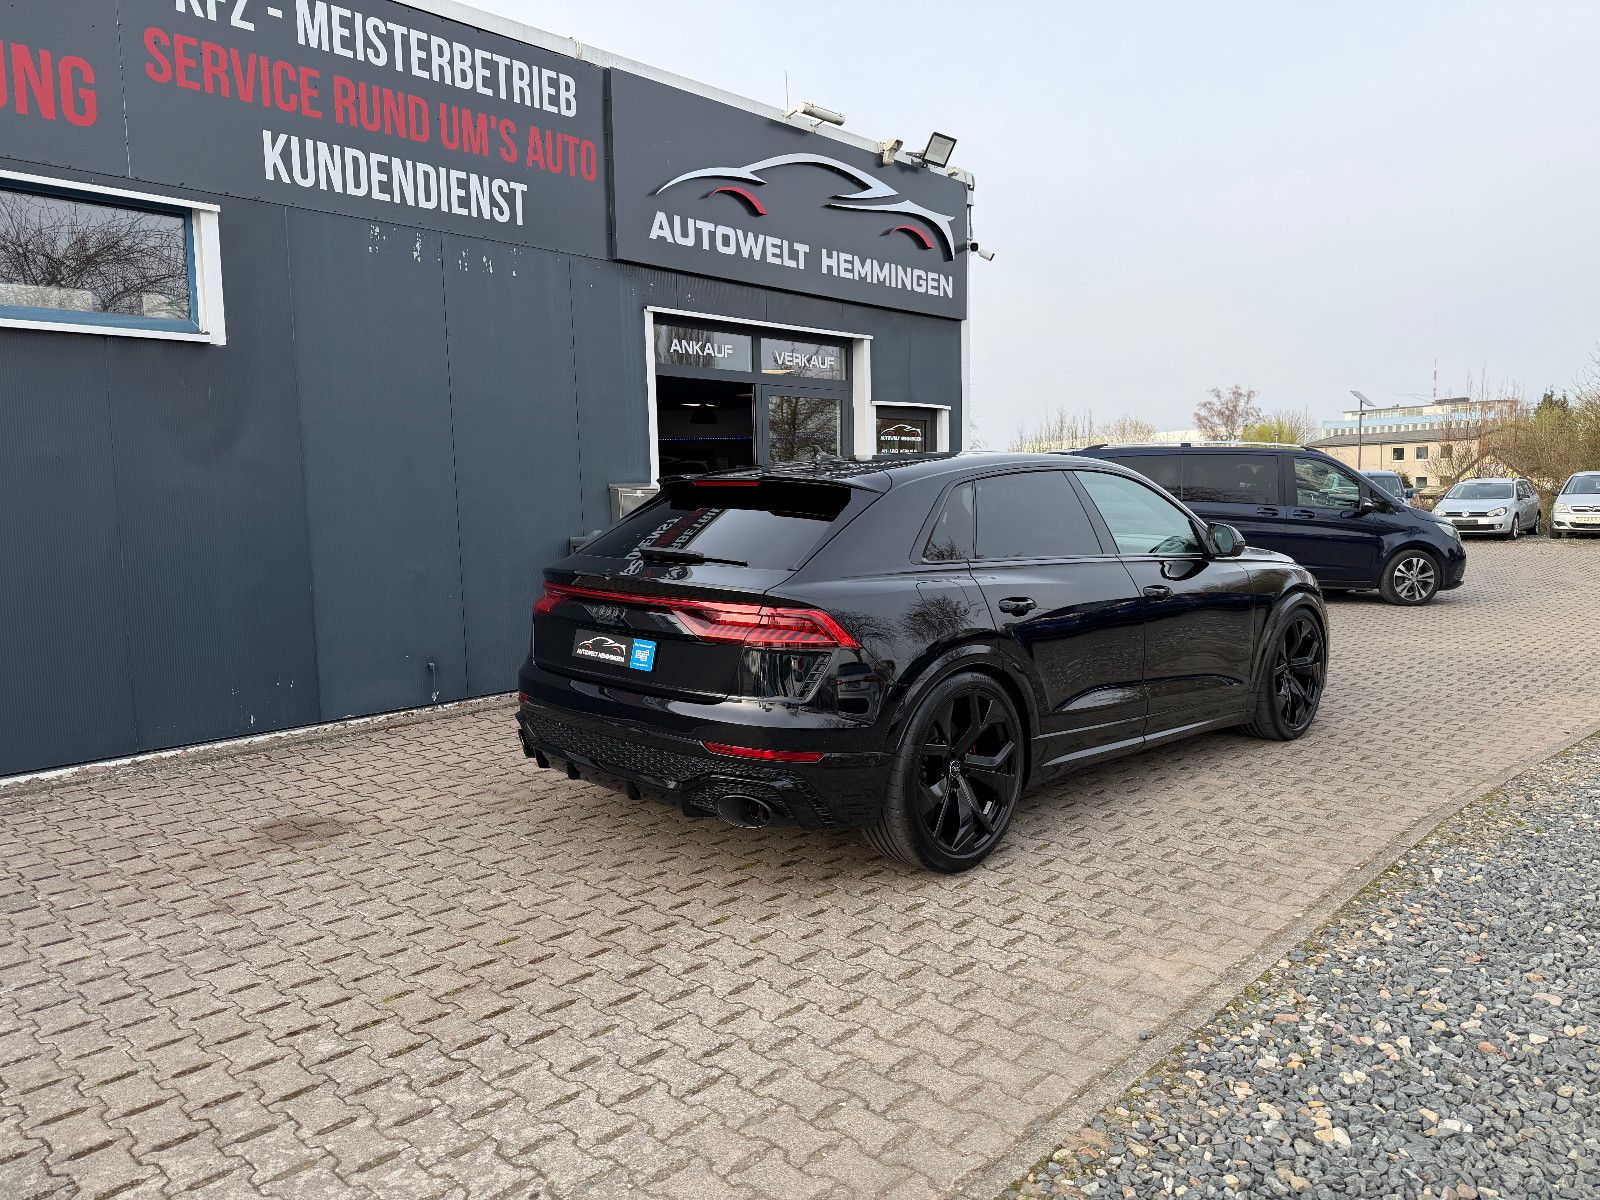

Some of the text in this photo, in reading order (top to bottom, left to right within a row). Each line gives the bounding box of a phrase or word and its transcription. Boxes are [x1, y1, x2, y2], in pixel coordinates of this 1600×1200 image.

[0, 40, 97, 127] NG
[295, 0, 577, 118] MEISTERBETRIEB
[143, 27, 597, 182] SERVICE RUND UM'S AUTO
[262, 129, 528, 226] KUNDENDIENST
[648, 210, 953, 299] AUTOWELT HEMMINGEN
[669, 338, 735, 360] ANKAUF
[775, 350, 835, 369] VERKAUF
